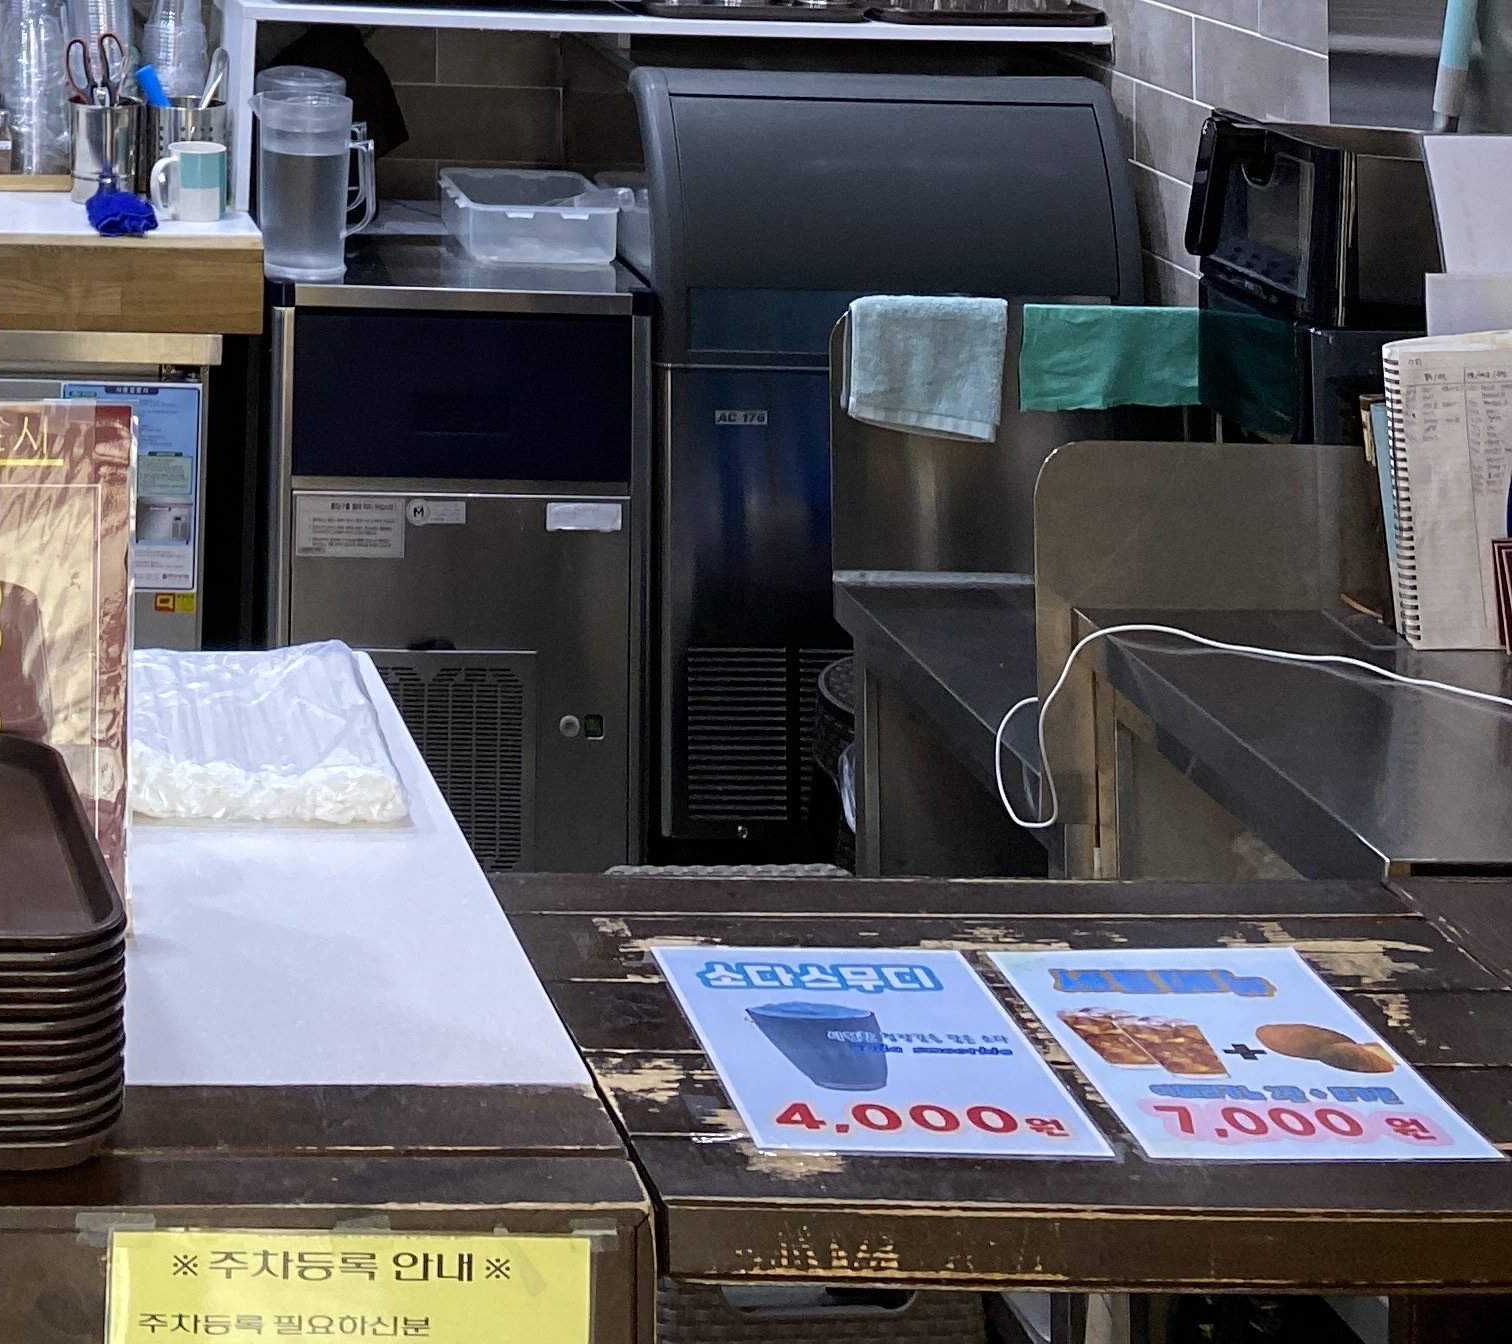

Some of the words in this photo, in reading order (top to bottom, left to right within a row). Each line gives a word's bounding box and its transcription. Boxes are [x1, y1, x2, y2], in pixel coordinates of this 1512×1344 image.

[705, 964, 935, 991] 소다스무디
[209, 1250, 377, 1282] 주차등록
[393, 1251, 473, 1282] 안내
[139, 1314, 263, 1334] 주차등록
[273, 1315, 430, 1336] 필요하신분
